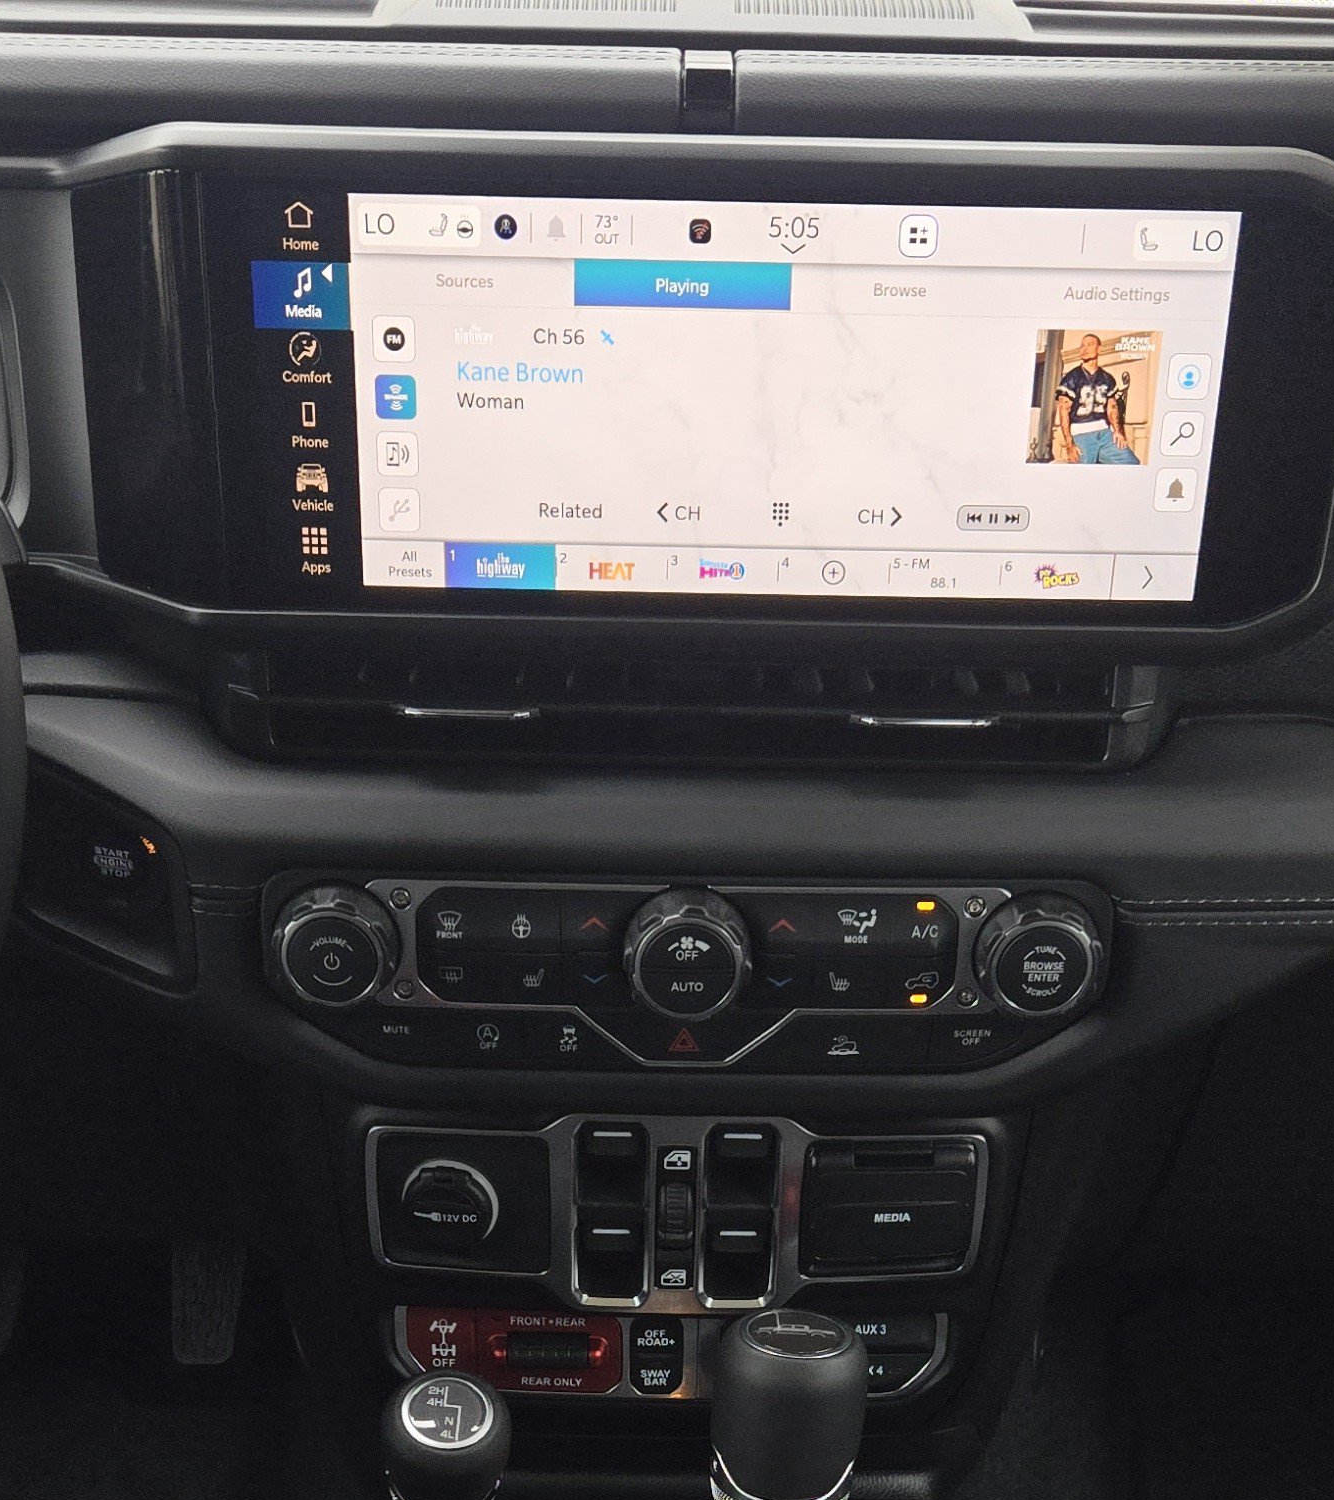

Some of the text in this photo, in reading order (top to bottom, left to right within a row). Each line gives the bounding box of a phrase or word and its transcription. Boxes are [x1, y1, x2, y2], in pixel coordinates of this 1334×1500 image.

[365, 213, 395, 235] LO
[595, 214, 619, 229] 73°
[768, 216, 820, 239] 5:05
[282, 237, 320, 251] Home
[594, 232, 619, 246] OUT
[1192, 230, 1224, 252] LO
[435, 273, 494, 290] Sources
[655, 277, 710, 298] Playing
[872, 282, 928, 298] Browse
[1063, 286, 1170, 305] Audio Settings
[285, 304, 323, 319] Media
[386, 334, 402, 345] FM
[533, 328, 557, 345] Ch
[562, 328, 586, 346] 56
[282, 370, 332, 384] Comfort
[456, 361, 584, 384] Kane Brown
[456, 392, 525, 410] Woman
[291, 435, 330, 449] Phone
[292, 499, 334, 512] Vehicle
[538, 502, 603, 520] Related
[675, 506, 701, 522] CH
[858, 509, 884, 524] CH
[401, 550, 417, 562] All
[449, 549, 455, 562] 1
[559, 553, 567, 564] 2
[670, 555, 678, 566] 3
[476, 557, 526, 579] highway
[781, 556, 789, 568] 4
[892, 558, 930, 570] 5 FM
[1004, 561, 1013, 572] 6
[301, 561, 332, 576] Apps
[388, 565, 433, 578] Presets
[589, 562, 635, 580] HEAT
[930, 577, 957, 589] 88.1
[1042, 573, 1080, 589] ROCKS
[94, 846, 130, 859] START
[93, 856, 134, 870] ENGINE
[101, 868, 131, 878] STOP
[436, 930, 463, 940] FRONT
[911, 924, 939, 940] A/C
[312, 936, 348, 948] VOLUME
[844, 935, 869, 944] MODE
[675, 950, 699, 962] OFF
[1035, 946, 1057, 954] TUNE
[1023, 961, 1065, 971] BROWSE
[1027, 973, 1060, 982] ENTER
[670, 981, 704, 993] AUTO
[1025, 986, 1057, 997] SCROLL
[383, 1025, 410, 1035] MUTE
[953, 1030, 991, 1038] SCREEN
[479, 1041, 498, 1050] OFF
[961, 1037, 981, 1046] OFF
[559, 1044, 578, 1052] OFF
[442, 1213, 478, 1223] 12V DC
[873, 1211, 911, 1223] MEDIA
[644, 1329, 666, 1338] OFF
[854, 1324, 887, 1335] AUX 3
[432, 1358, 456, 1368] OFF
[640, 1369, 671, 1379] SWAY
[876, 1365, 884, 1376] 4
[521, 1376, 583, 1387] REAR ONLY
[644, 1377, 667, 1387] BAR
[428, 1386, 445, 1395] 2H
[427, 1398, 443, 1407] 4H
[444, 1416, 454, 1426] N
[440, 1429, 455, 1439] 4L
